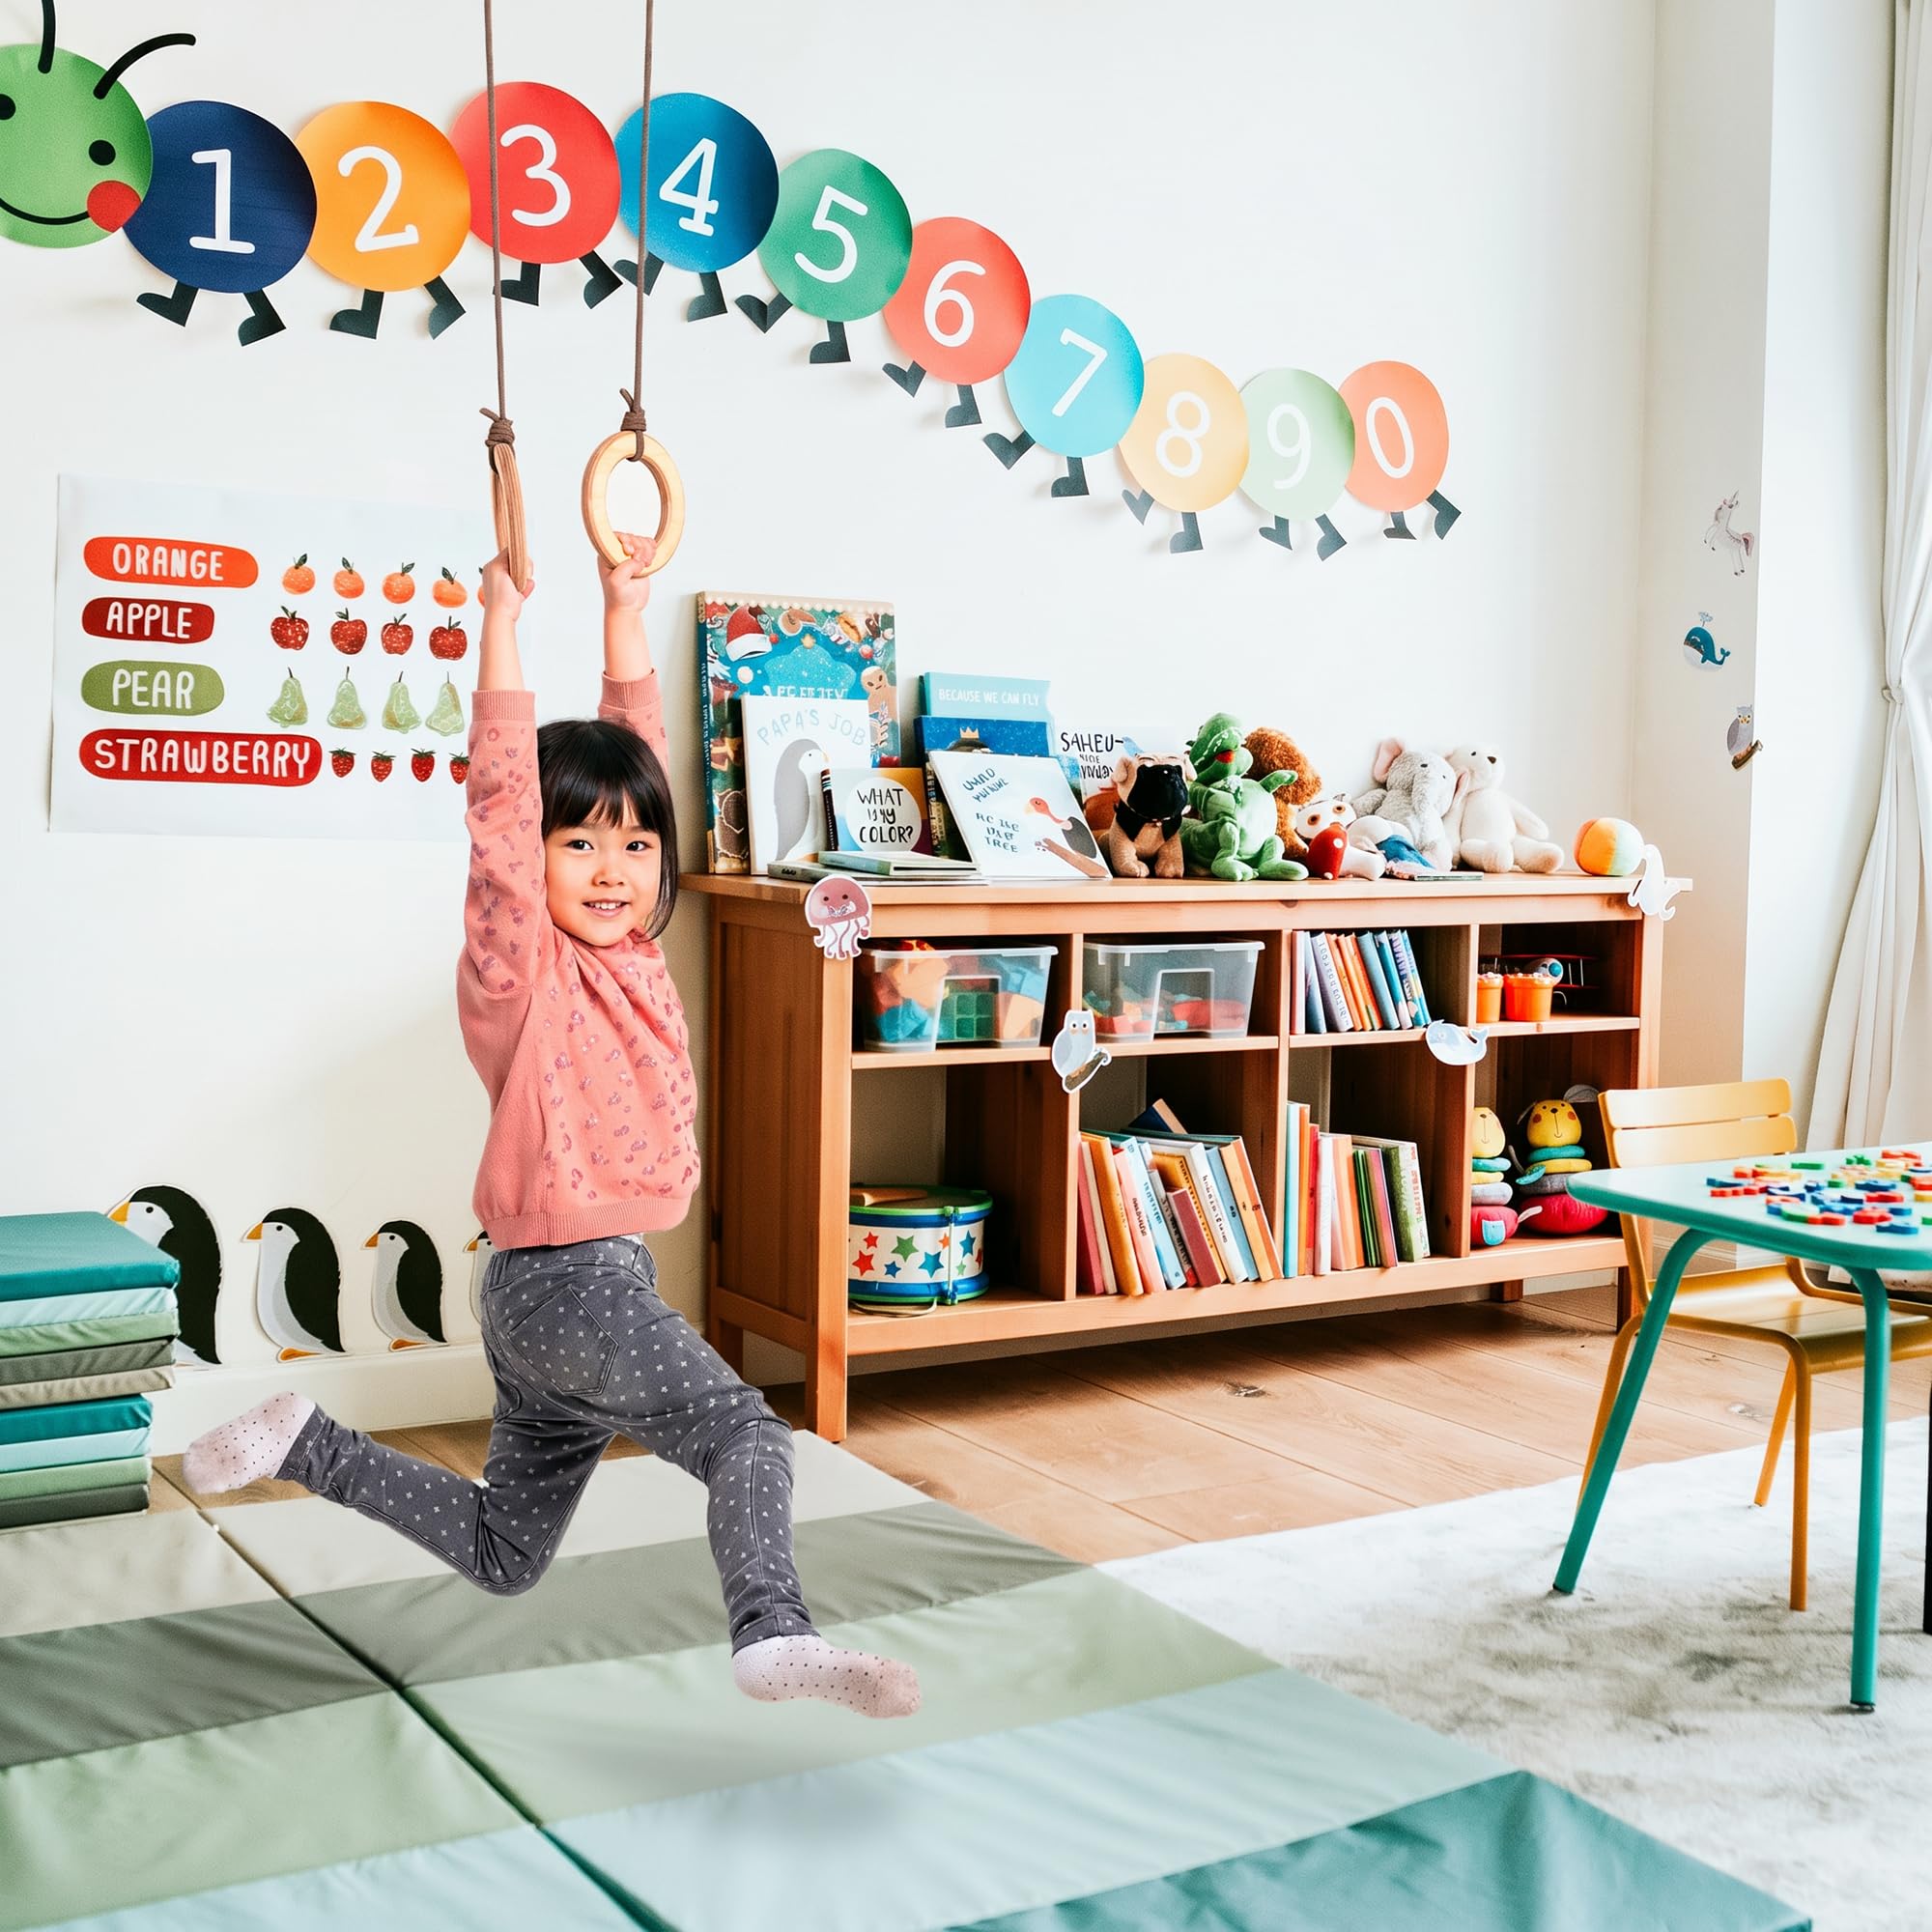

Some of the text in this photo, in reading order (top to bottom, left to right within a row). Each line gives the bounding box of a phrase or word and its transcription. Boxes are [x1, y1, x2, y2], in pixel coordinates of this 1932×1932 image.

[189, 124, 1415, 489] 1 2 3 4 5 6 7 8 9 0
[111, 543, 225, 582] ORANGE
[105, 601, 192, 639] APPLE
[112, 668, 194, 709] PEAR
[938, 689, 981, 703] BECAUSE
[982, 691, 999, 704] WE
[1001, 693, 1020, 705] CAN
[756, 708, 867, 747] PAPA'S JOB
[94, 739, 311, 779] STRAWBERRY
[856, 787, 904, 807] WHAT
[859, 825, 914, 843] COLOR?
